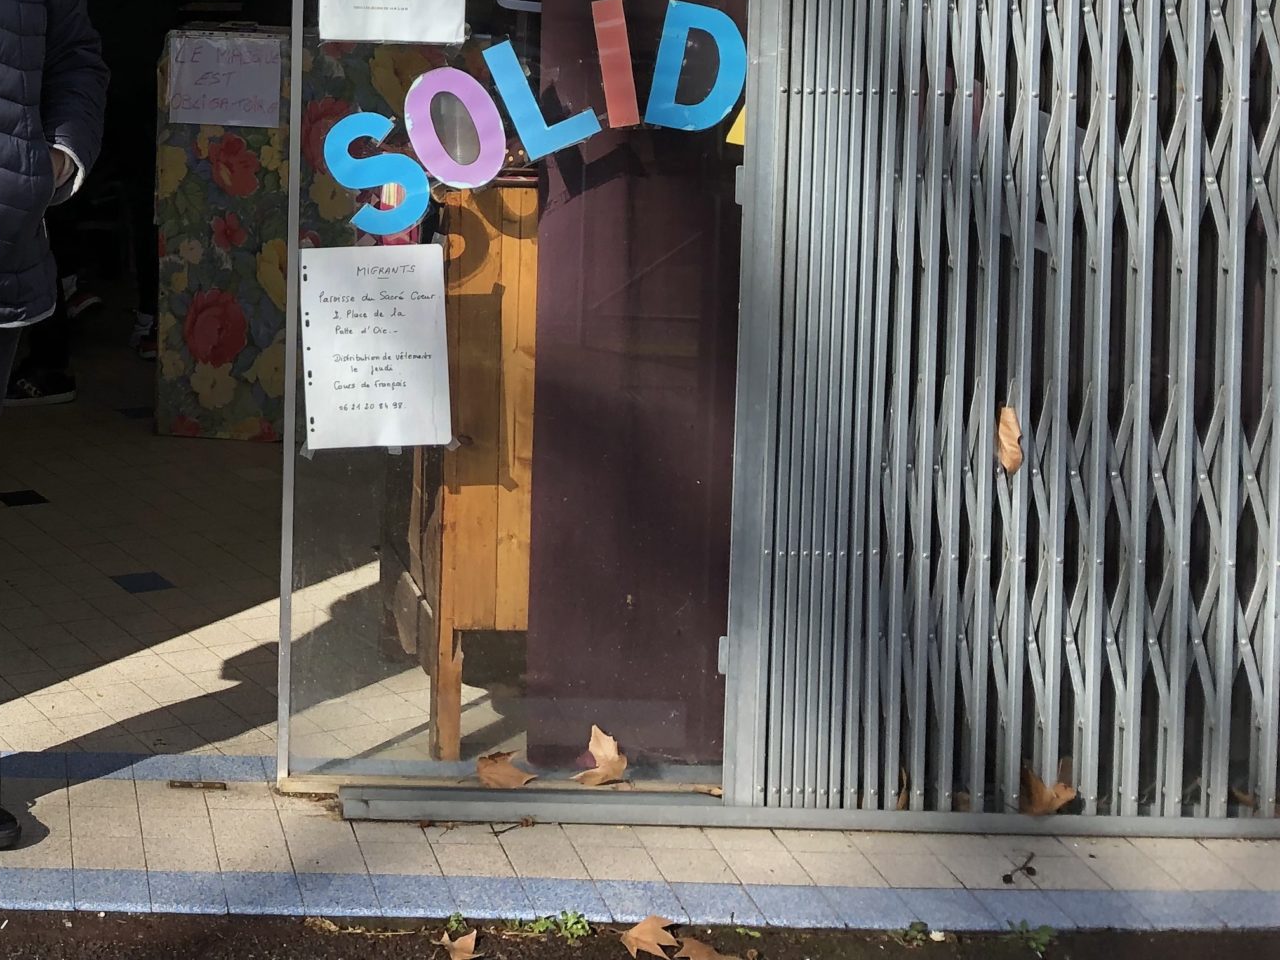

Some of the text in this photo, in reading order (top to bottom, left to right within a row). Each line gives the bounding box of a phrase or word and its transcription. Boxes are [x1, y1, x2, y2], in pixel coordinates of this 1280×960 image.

[194, 71, 236, 87] EST
[356, 264, 416, 277] MIGRANTS
[374, 309, 385, 318] de
